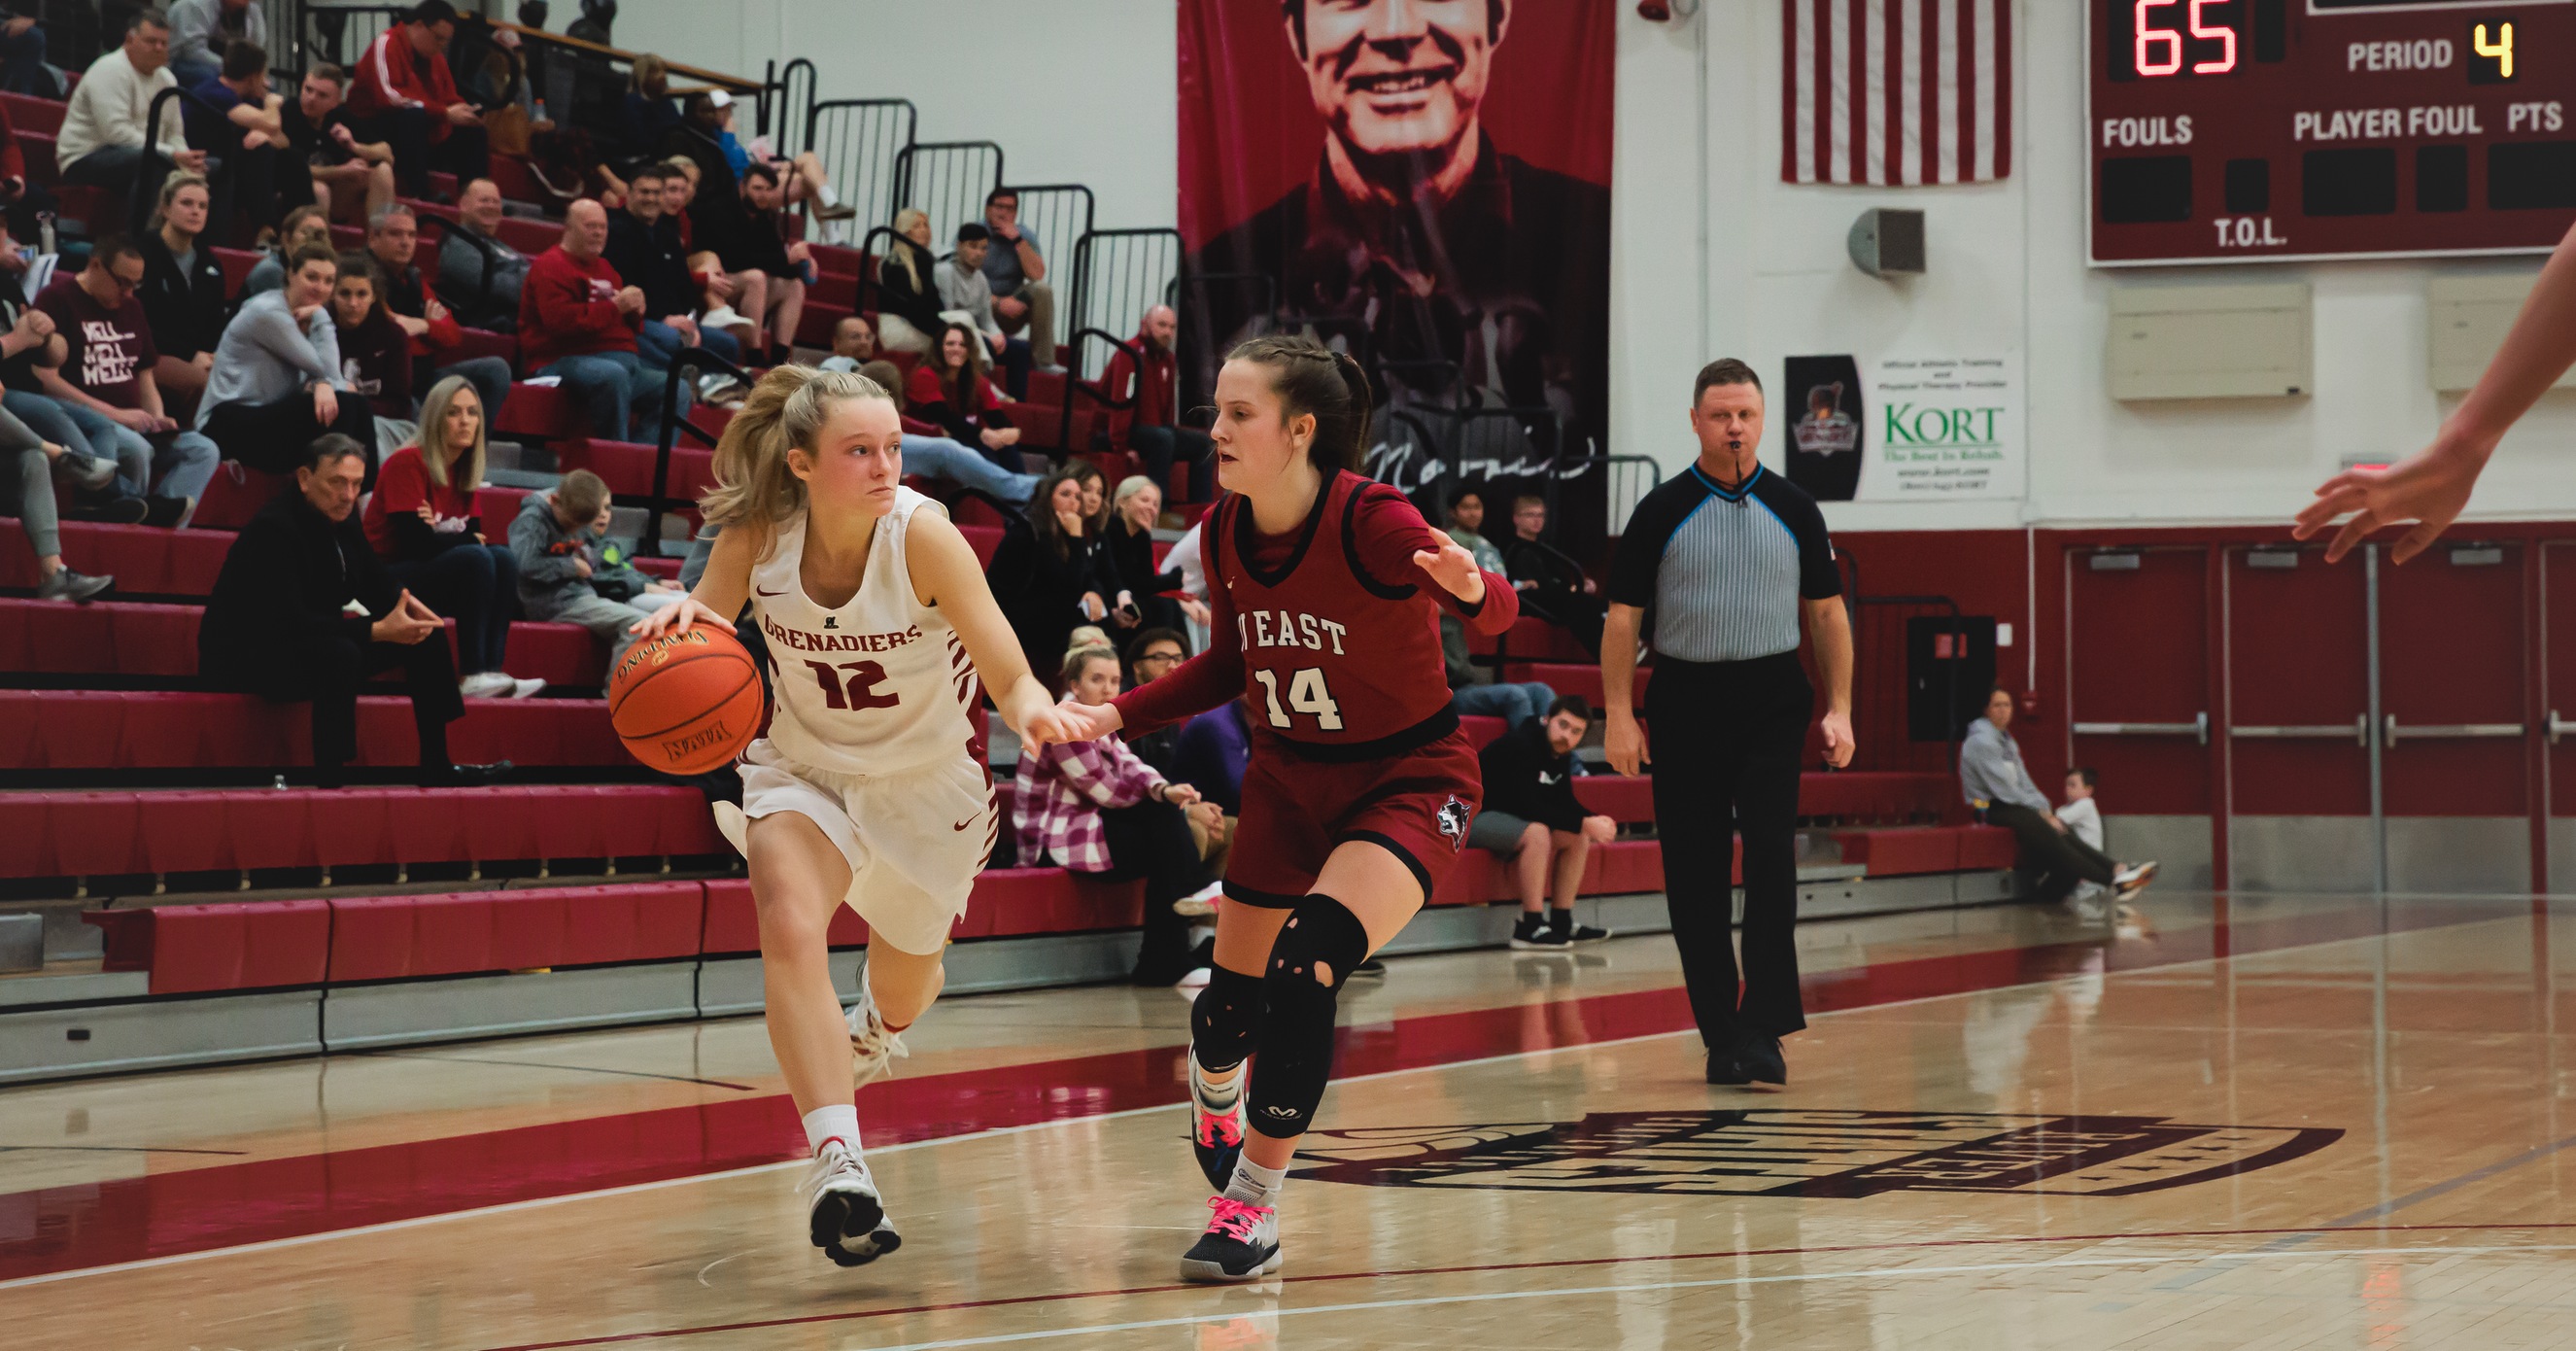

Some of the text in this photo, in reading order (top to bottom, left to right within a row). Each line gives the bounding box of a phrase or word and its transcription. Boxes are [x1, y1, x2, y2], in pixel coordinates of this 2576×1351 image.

[2135, 0, 2237, 77] 65
[2348, 40, 2454, 71] PERIOD
[2474, 22, 2514, 78] 4
[2103, 116, 2192, 147] FOULS
[2294, 105, 2483, 140] PLAYER FOUL
[2508, 102, 2563, 132] PTS
[2215, 218, 2287, 246] T.O.L.
[764, 613, 923, 653] GRENADIERS
[1253, 609, 1347, 655] EAST
[804, 659, 901, 711] 12
[1254, 667, 1344, 730] 14
[1855, 1131, 2147, 1181] RIVER
